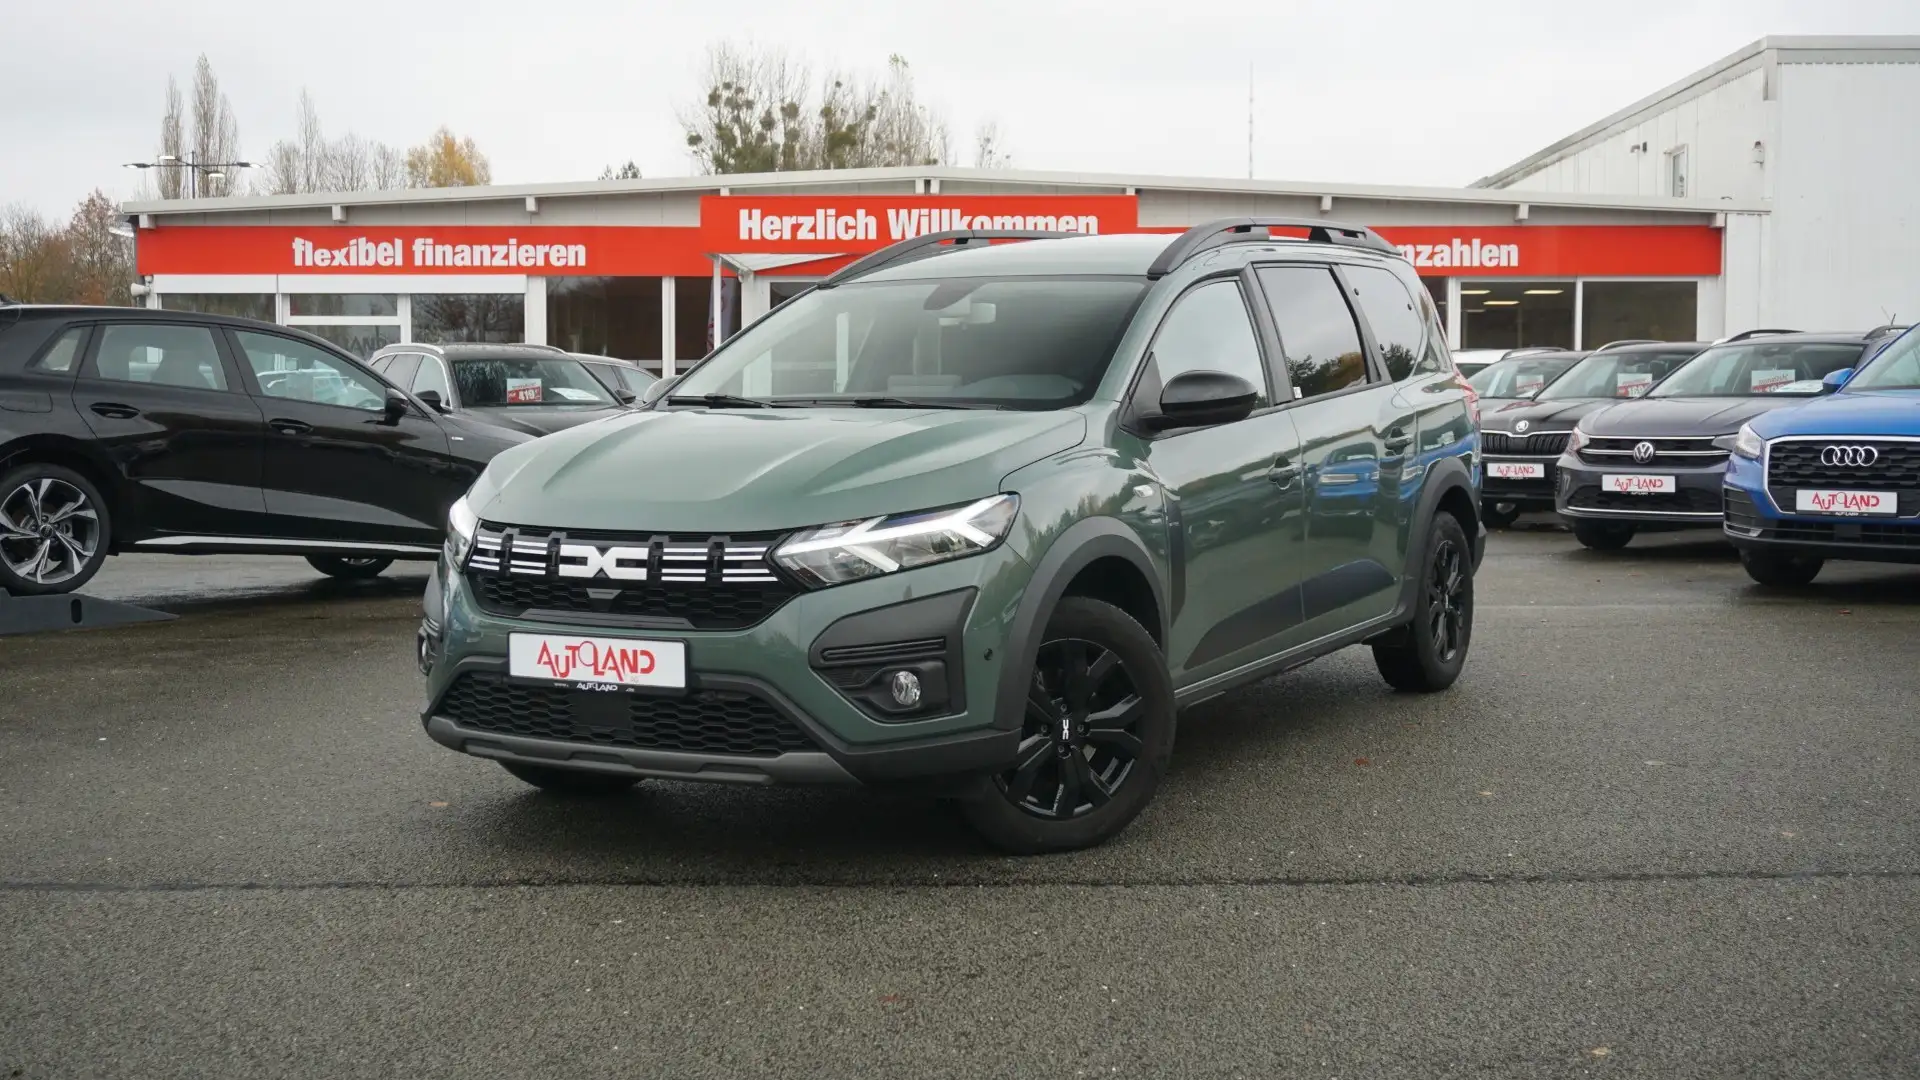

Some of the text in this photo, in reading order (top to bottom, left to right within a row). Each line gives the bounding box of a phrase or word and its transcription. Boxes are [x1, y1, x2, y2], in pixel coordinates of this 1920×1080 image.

[739, 208, 1099, 240] Herzlich Willkommen
[292, 237, 586, 266] flexibel finanzieren
[1812, 491, 1880, 511] AUTOLAND
[537, 640, 656, 682] AUTOLAND
